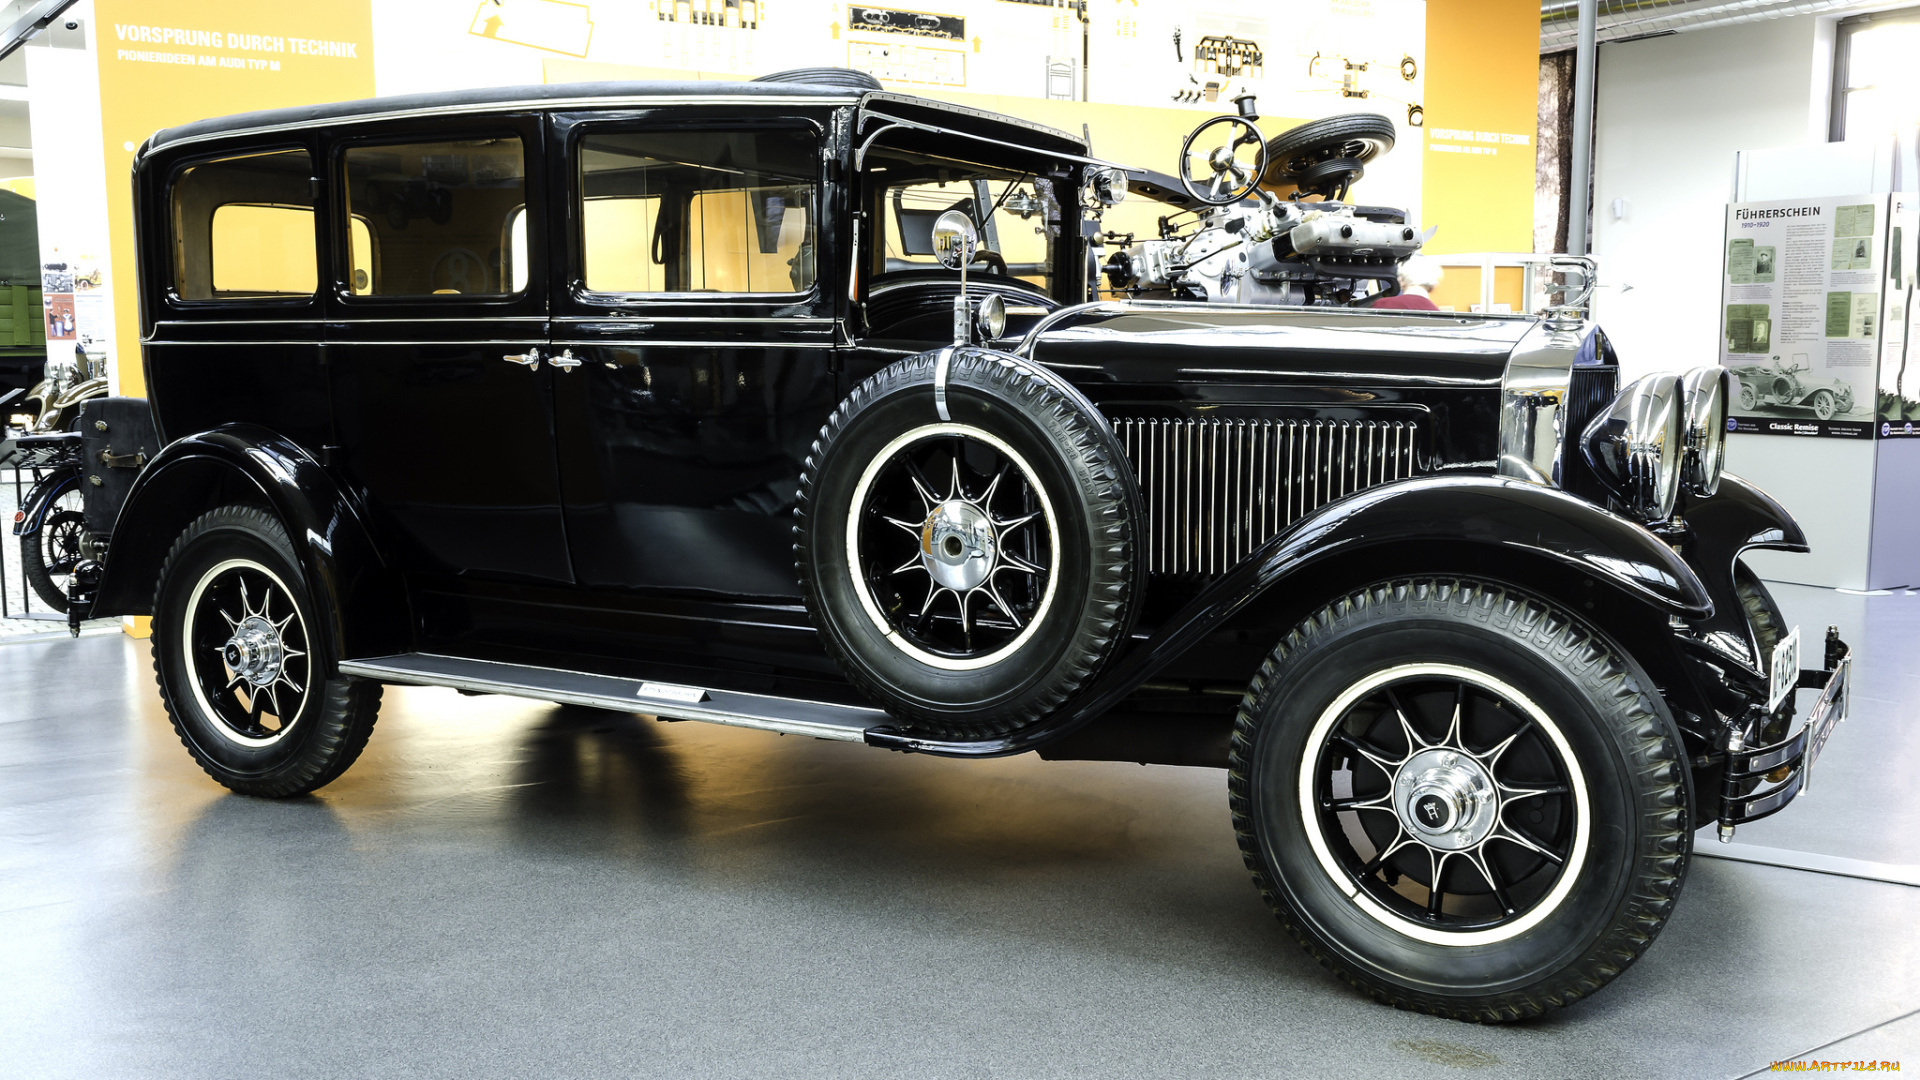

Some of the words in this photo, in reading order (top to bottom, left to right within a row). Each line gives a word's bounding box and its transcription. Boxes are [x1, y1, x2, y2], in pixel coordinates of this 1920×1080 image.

[114, 24, 222, 48] VORSPRUNG
[227, 33, 284, 52] DURCH
[287, 38, 357, 58] TECHNIK
[117, 49, 195, 65] PIONIERIDEEN
[198, 55, 216, 67] AM
[218, 57, 245, 69] AUDI
[247, 59, 267, 71] TYP
[270, 61, 280, 71] M
[1429, 127, 1474, 141] VORSPRUNG
[1475, 131, 1499, 143] DURCH
[1500, 133, 1530, 145] TECHNIK
[1736, 206, 1821, 220] FÜHRERSCHEIN
[1794, 423, 1819, 431] Remise
